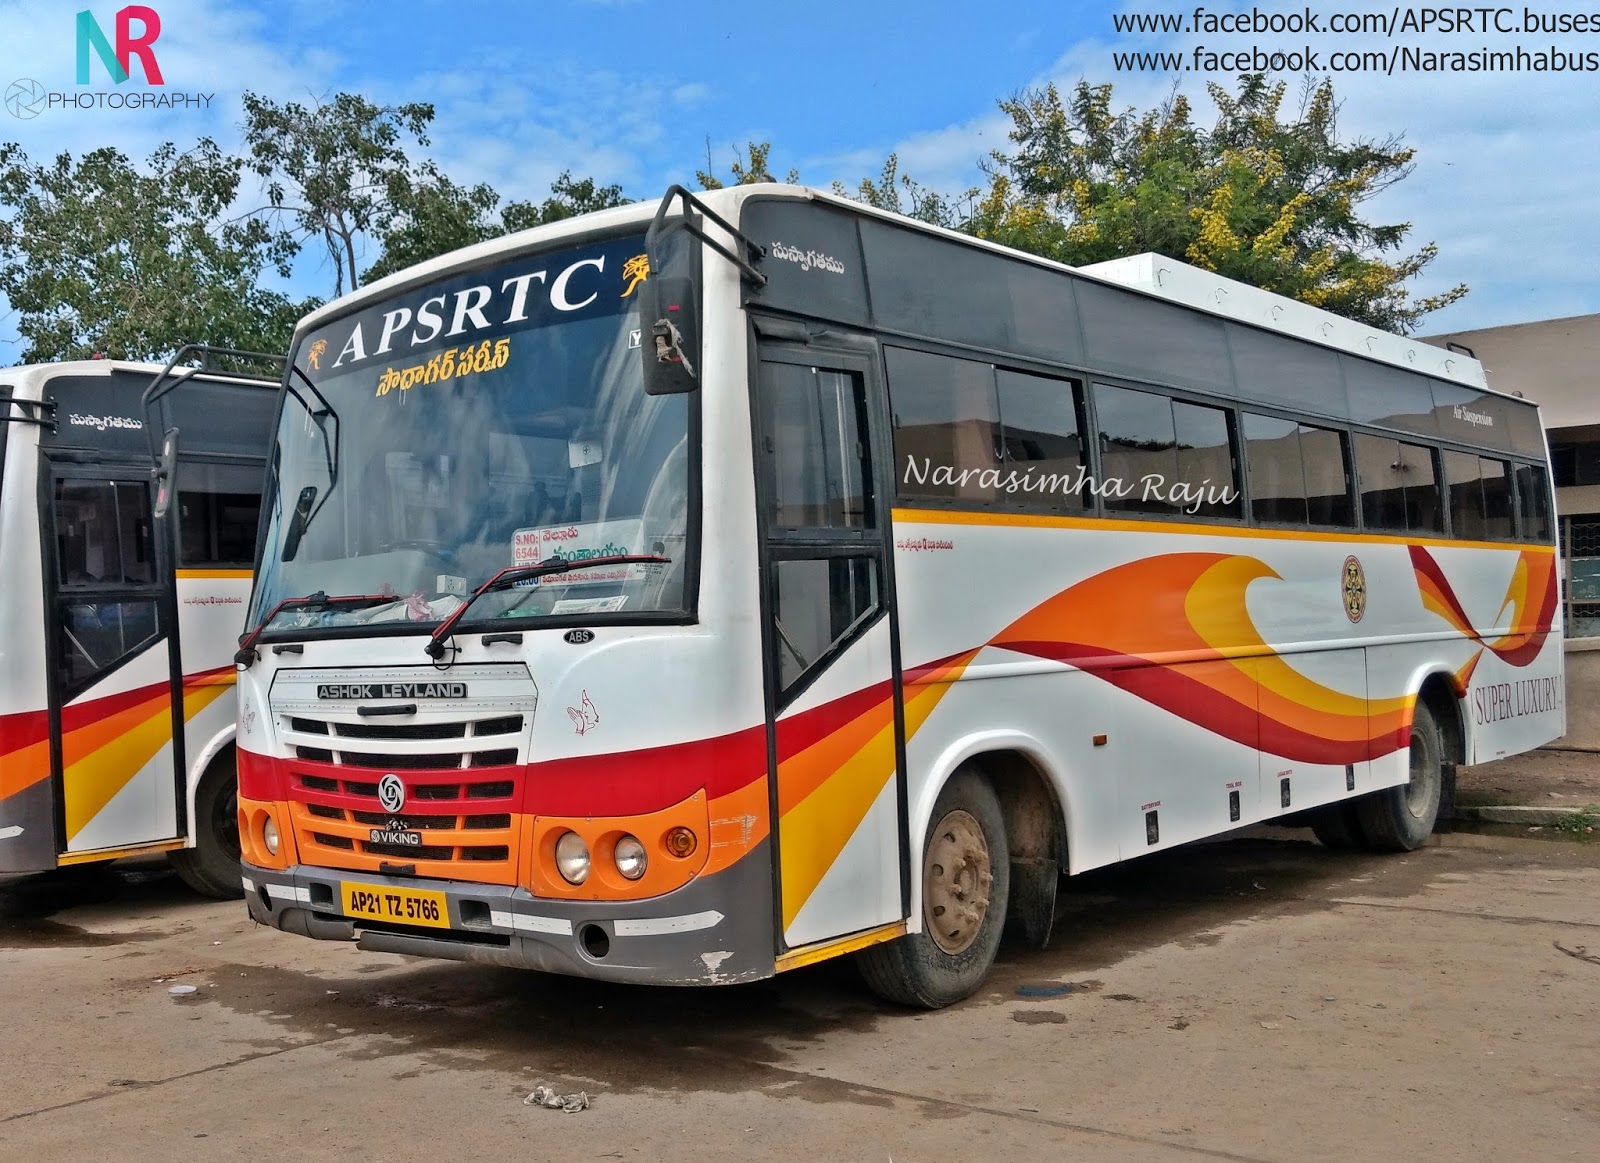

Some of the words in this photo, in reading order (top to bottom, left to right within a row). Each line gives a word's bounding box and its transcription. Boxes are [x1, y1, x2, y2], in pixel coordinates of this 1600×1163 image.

[331, 255, 605, 368] APSRTC
[1453, 404, 1463, 420] Air
[1462, 405, 1493, 427] Suspension
[515, 533, 539, 545] S.NO:
[515, 546, 539, 559] 6544
[568, 631, 589, 642] ABS
[319, 685, 373, 698] ASHOK
[381, 683, 465, 698] LEYLAND
[1475, 683, 1514, 726] SUPER
[1515, 676, 1558, 717] LUXURY
[380, 831, 419, 845] VIKING
[351, 890, 382, 914] AP21
[385, 894, 404, 918] TZ
[406, 897, 440, 921] 5766
